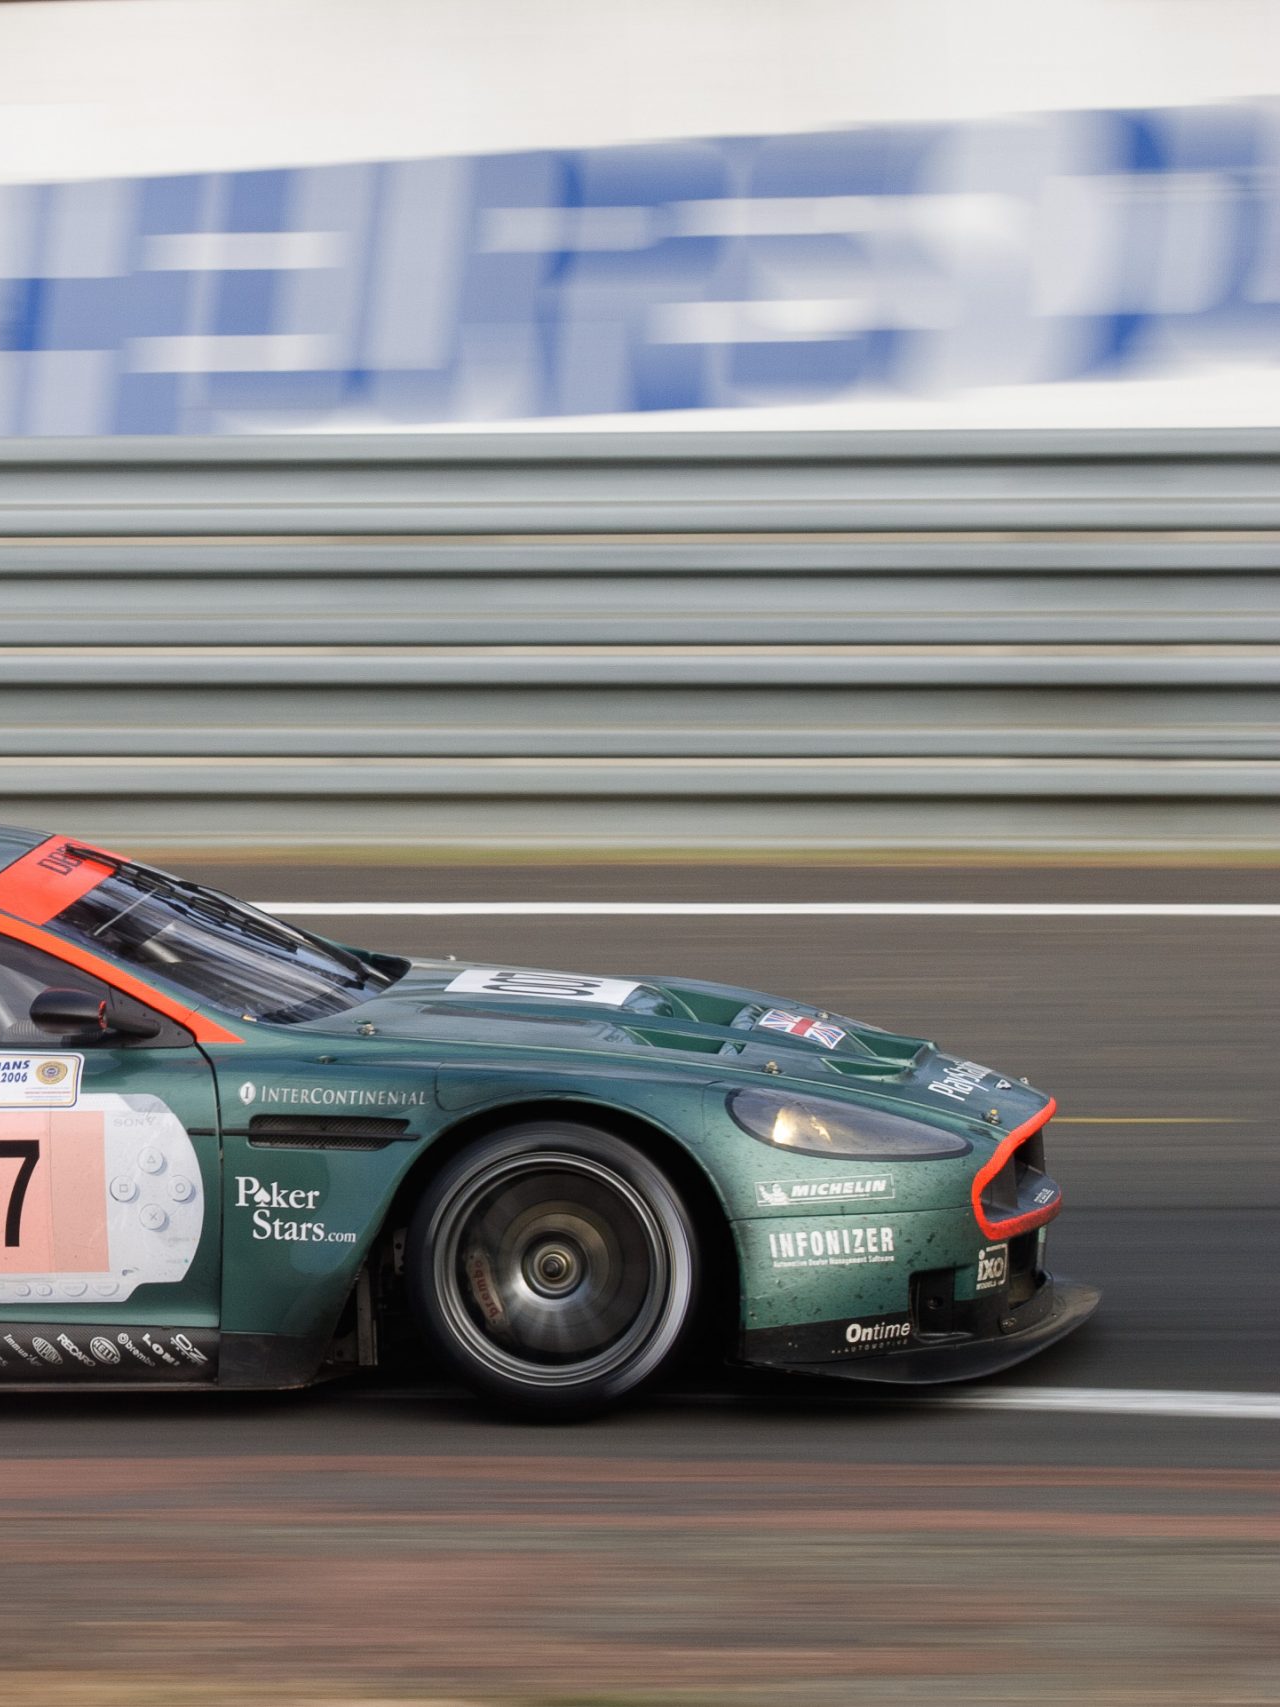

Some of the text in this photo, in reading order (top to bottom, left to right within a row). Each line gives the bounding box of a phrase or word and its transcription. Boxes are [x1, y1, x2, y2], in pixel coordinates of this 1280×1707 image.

[0, 1072, 28, 1083] 2006
[261, 1086, 426, 1105] INTERCONTINENTAL
[791, 1180, 887, 1197] MICHELIN
[252, 1209, 357, 1243] Stars.com
[769, 1227, 895, 1258] INFONIZER
[846, 1322, 911, 1342] Ontime
[57, 1333, 96, 1367] RECARO
[92, 1339, 120, 1364] HELLA
[124, 1340, 156, 1367] brembo
